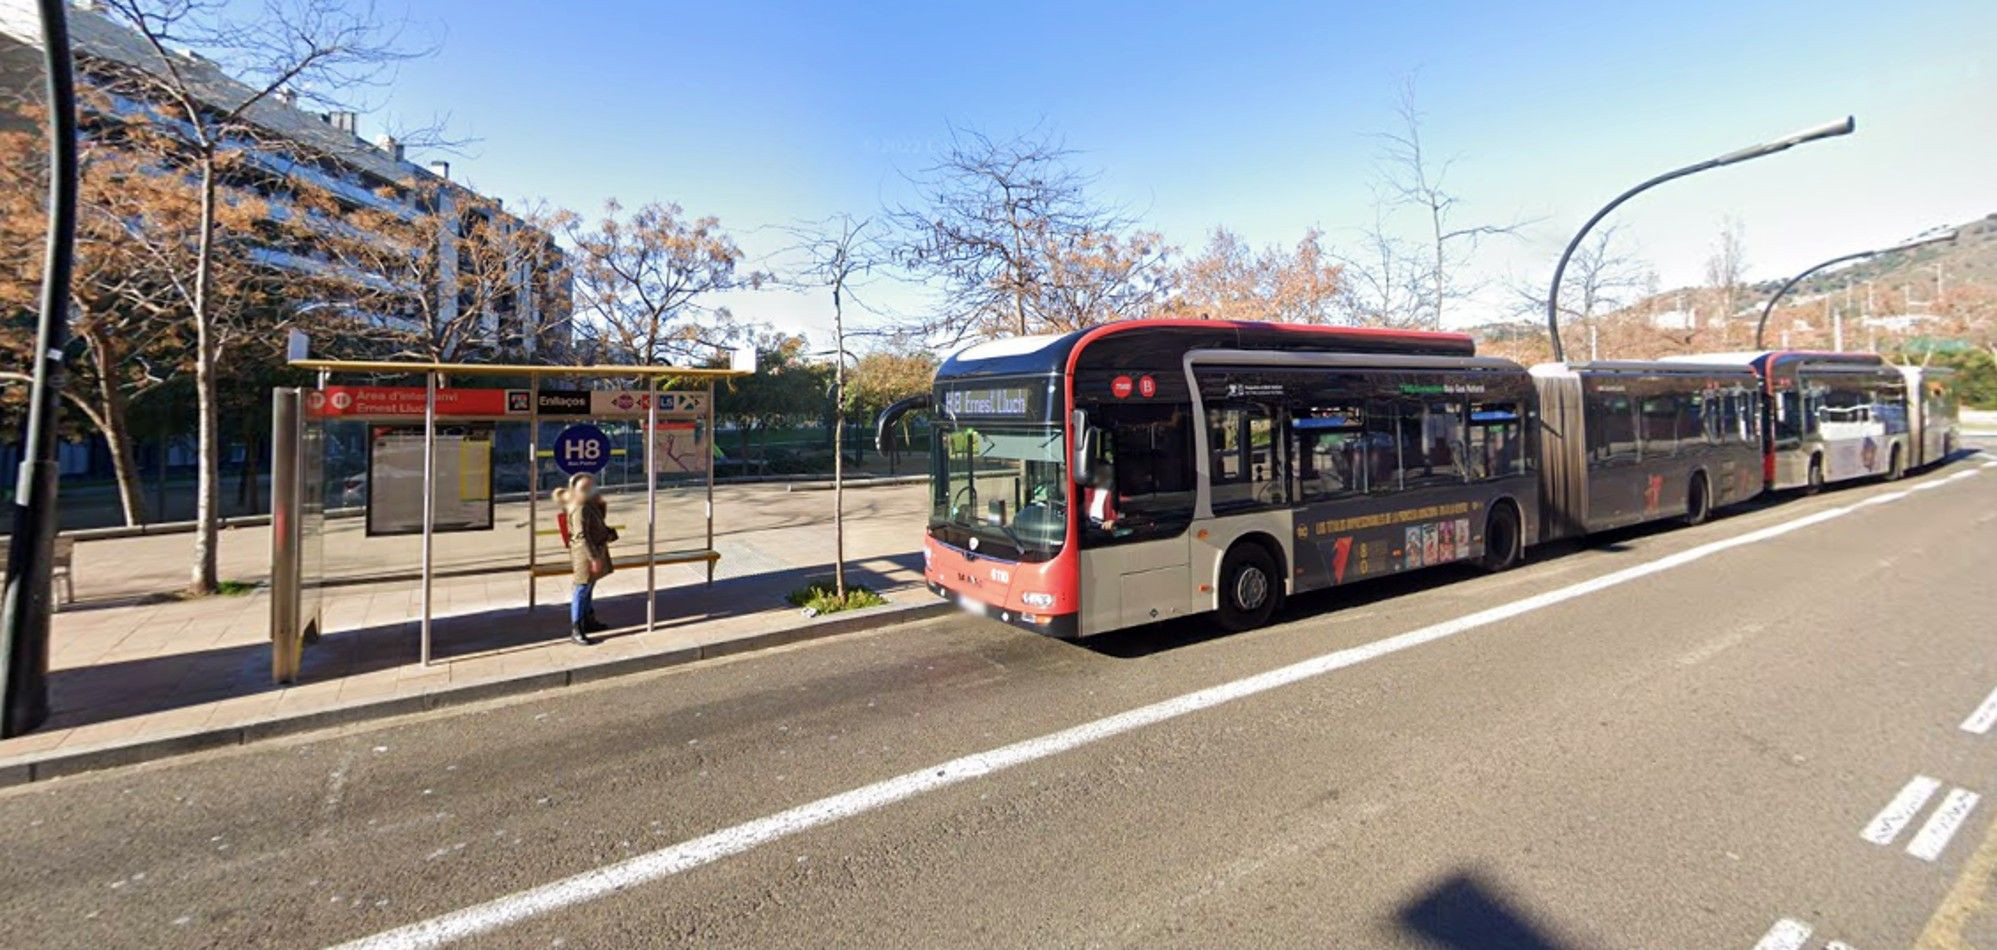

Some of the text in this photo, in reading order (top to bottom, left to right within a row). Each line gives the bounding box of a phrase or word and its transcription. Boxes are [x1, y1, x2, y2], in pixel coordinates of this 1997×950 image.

[357, 403, 427, 413] Ernest Lluc
[539, 395, 586, 408] Enllaços
[565, 438, 601, 460] H8
